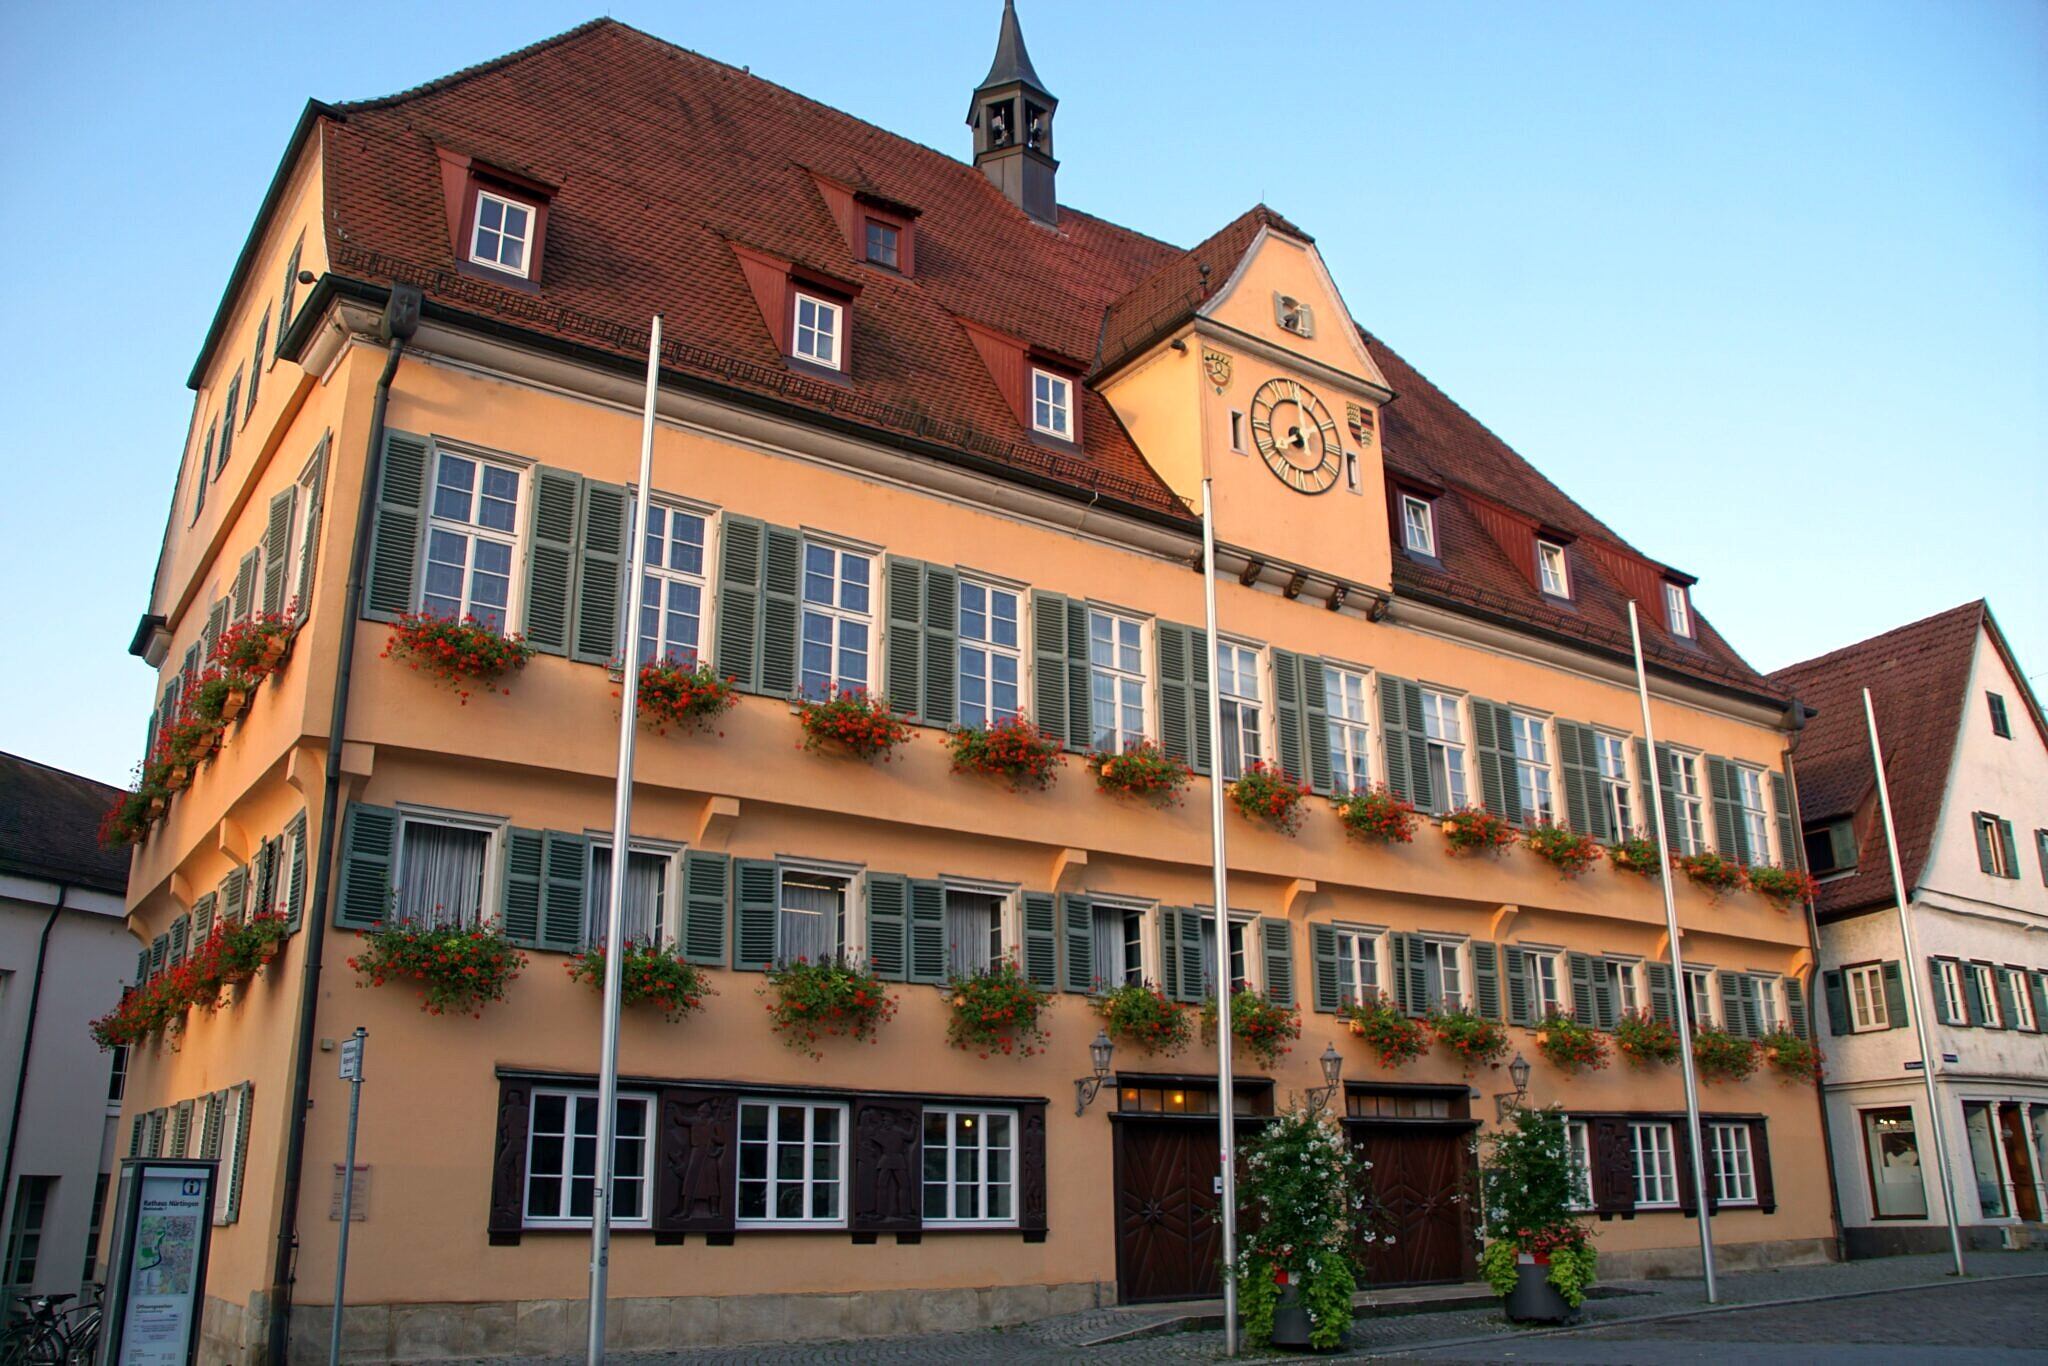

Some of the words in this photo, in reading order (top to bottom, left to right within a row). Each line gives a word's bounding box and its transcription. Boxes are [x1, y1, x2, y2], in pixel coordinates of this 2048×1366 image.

[1309, 397, 1316, 411] I
[1320, 419, 1335, 431] II
[1325, 444, 1341, 456] III
[1313, 470, 1326, 490] V
[168, 1200, 199, 1208] Nürtingen
